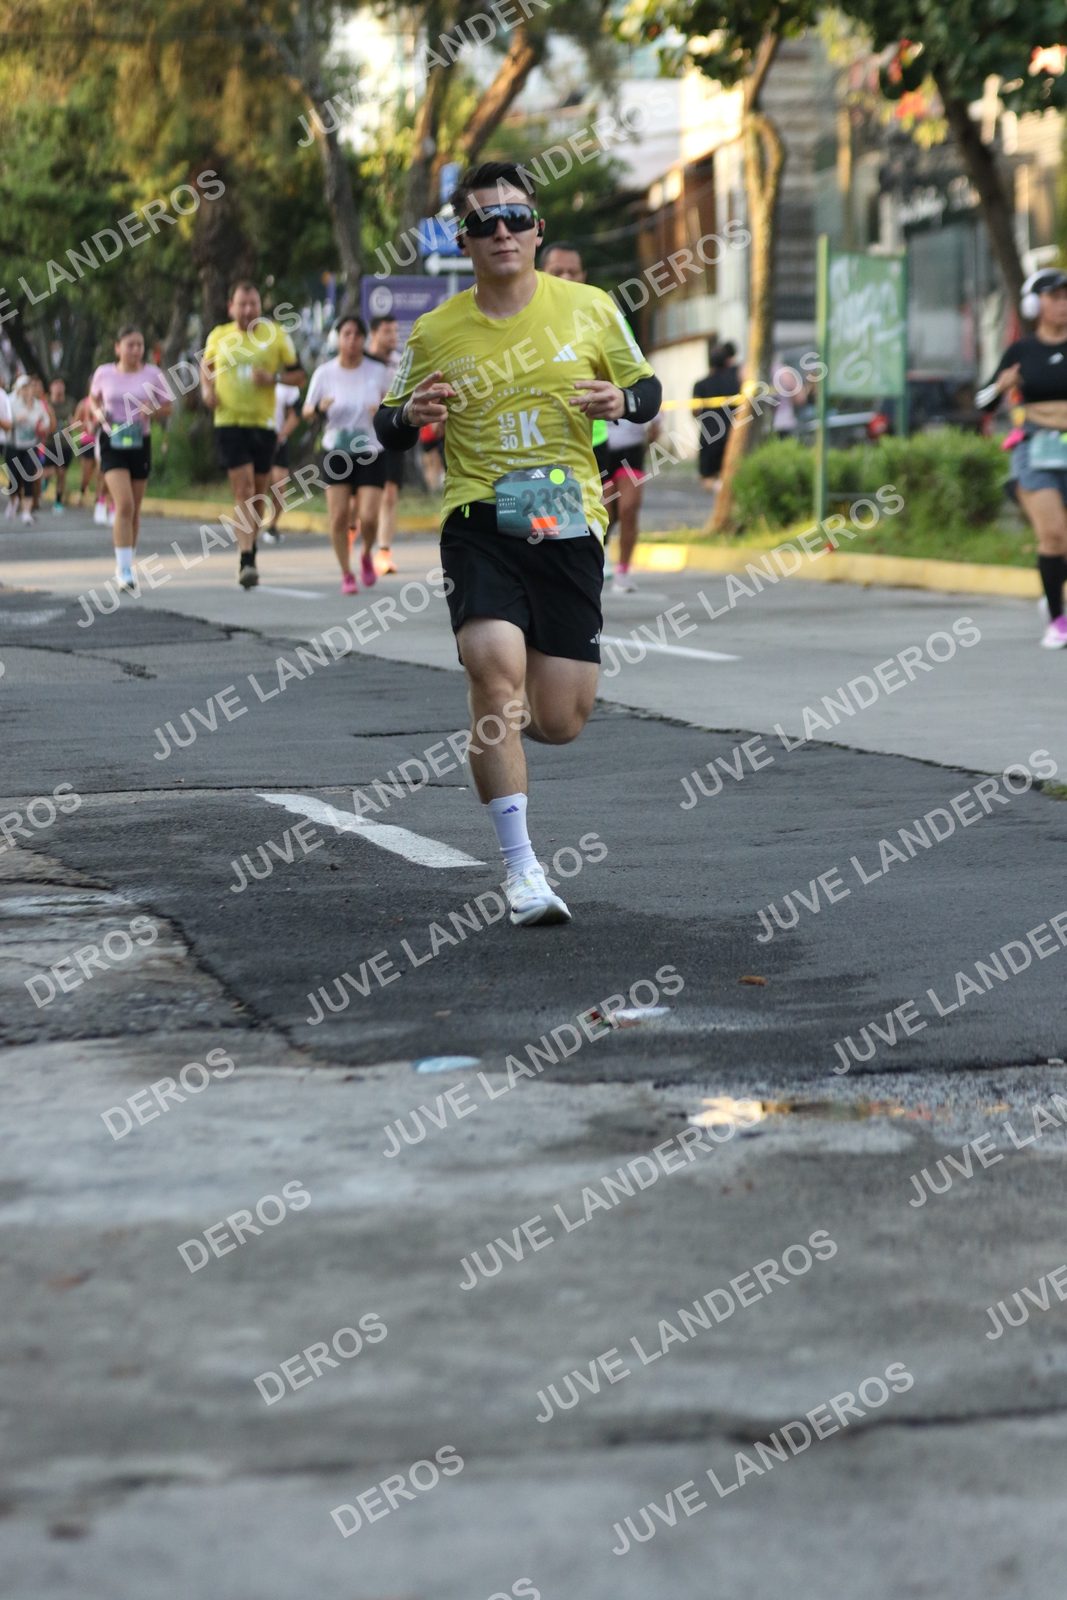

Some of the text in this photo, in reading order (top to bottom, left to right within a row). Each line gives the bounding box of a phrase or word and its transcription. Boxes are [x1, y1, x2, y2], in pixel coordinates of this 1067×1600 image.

[497, 412, 516, 429] 15
[519, 408, 546, 448] K
[501, 434, 519, 451] 30
